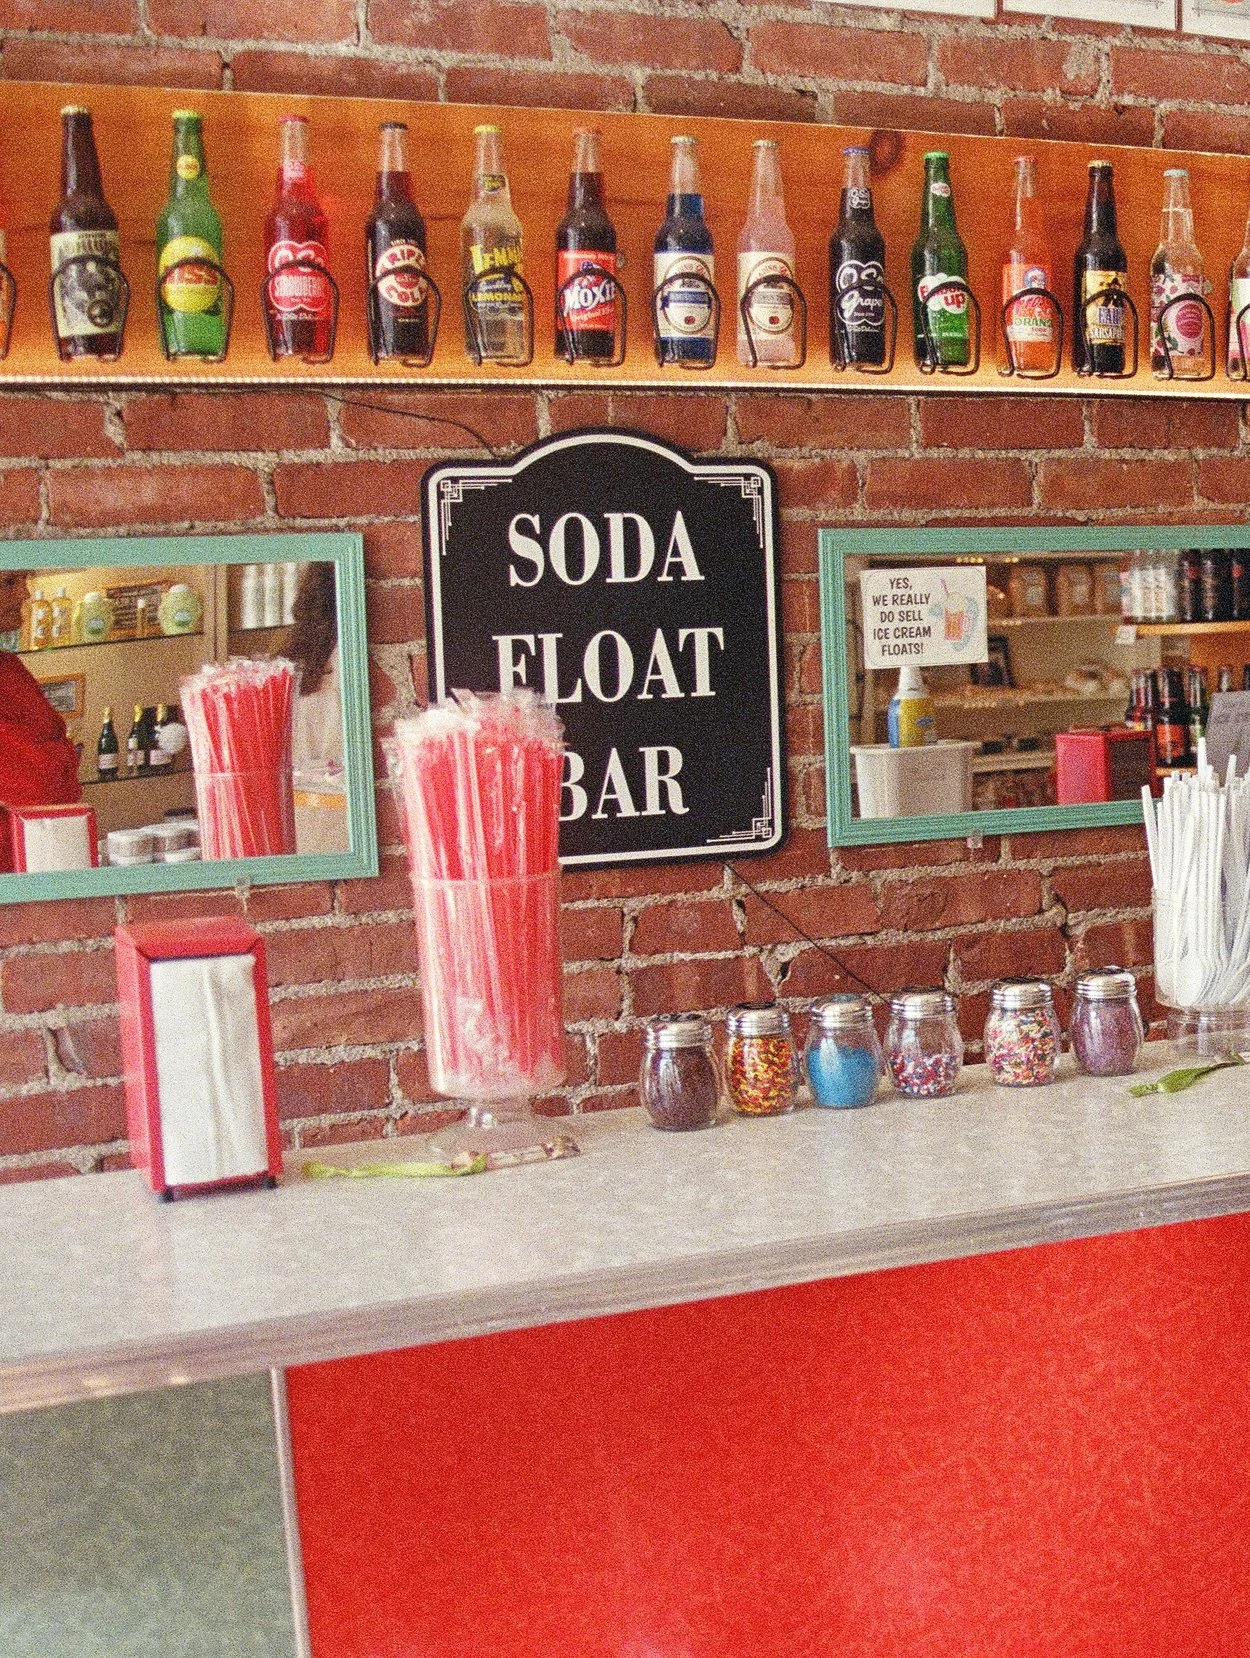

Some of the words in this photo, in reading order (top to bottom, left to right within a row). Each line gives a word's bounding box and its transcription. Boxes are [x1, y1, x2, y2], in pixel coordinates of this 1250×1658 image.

[944, 293, 965, 309] up
[508, 510, 705, 588] SODA
[889, 576, 913, 590] YES,
[872, 594, 888, 607] WE
[891, 593, 931, 607] REALLY
[880, 610, 895, 623] DO
[898, 610, 923, 623] SELL
[873, 628, 890, 640] ICE
[893, 626, 932, 639] CREAM
[881, 642, 924, 656] FLOATS!
[492, 626, 725, 705] FLOAT
[558, 745, 690, 822] BAR
